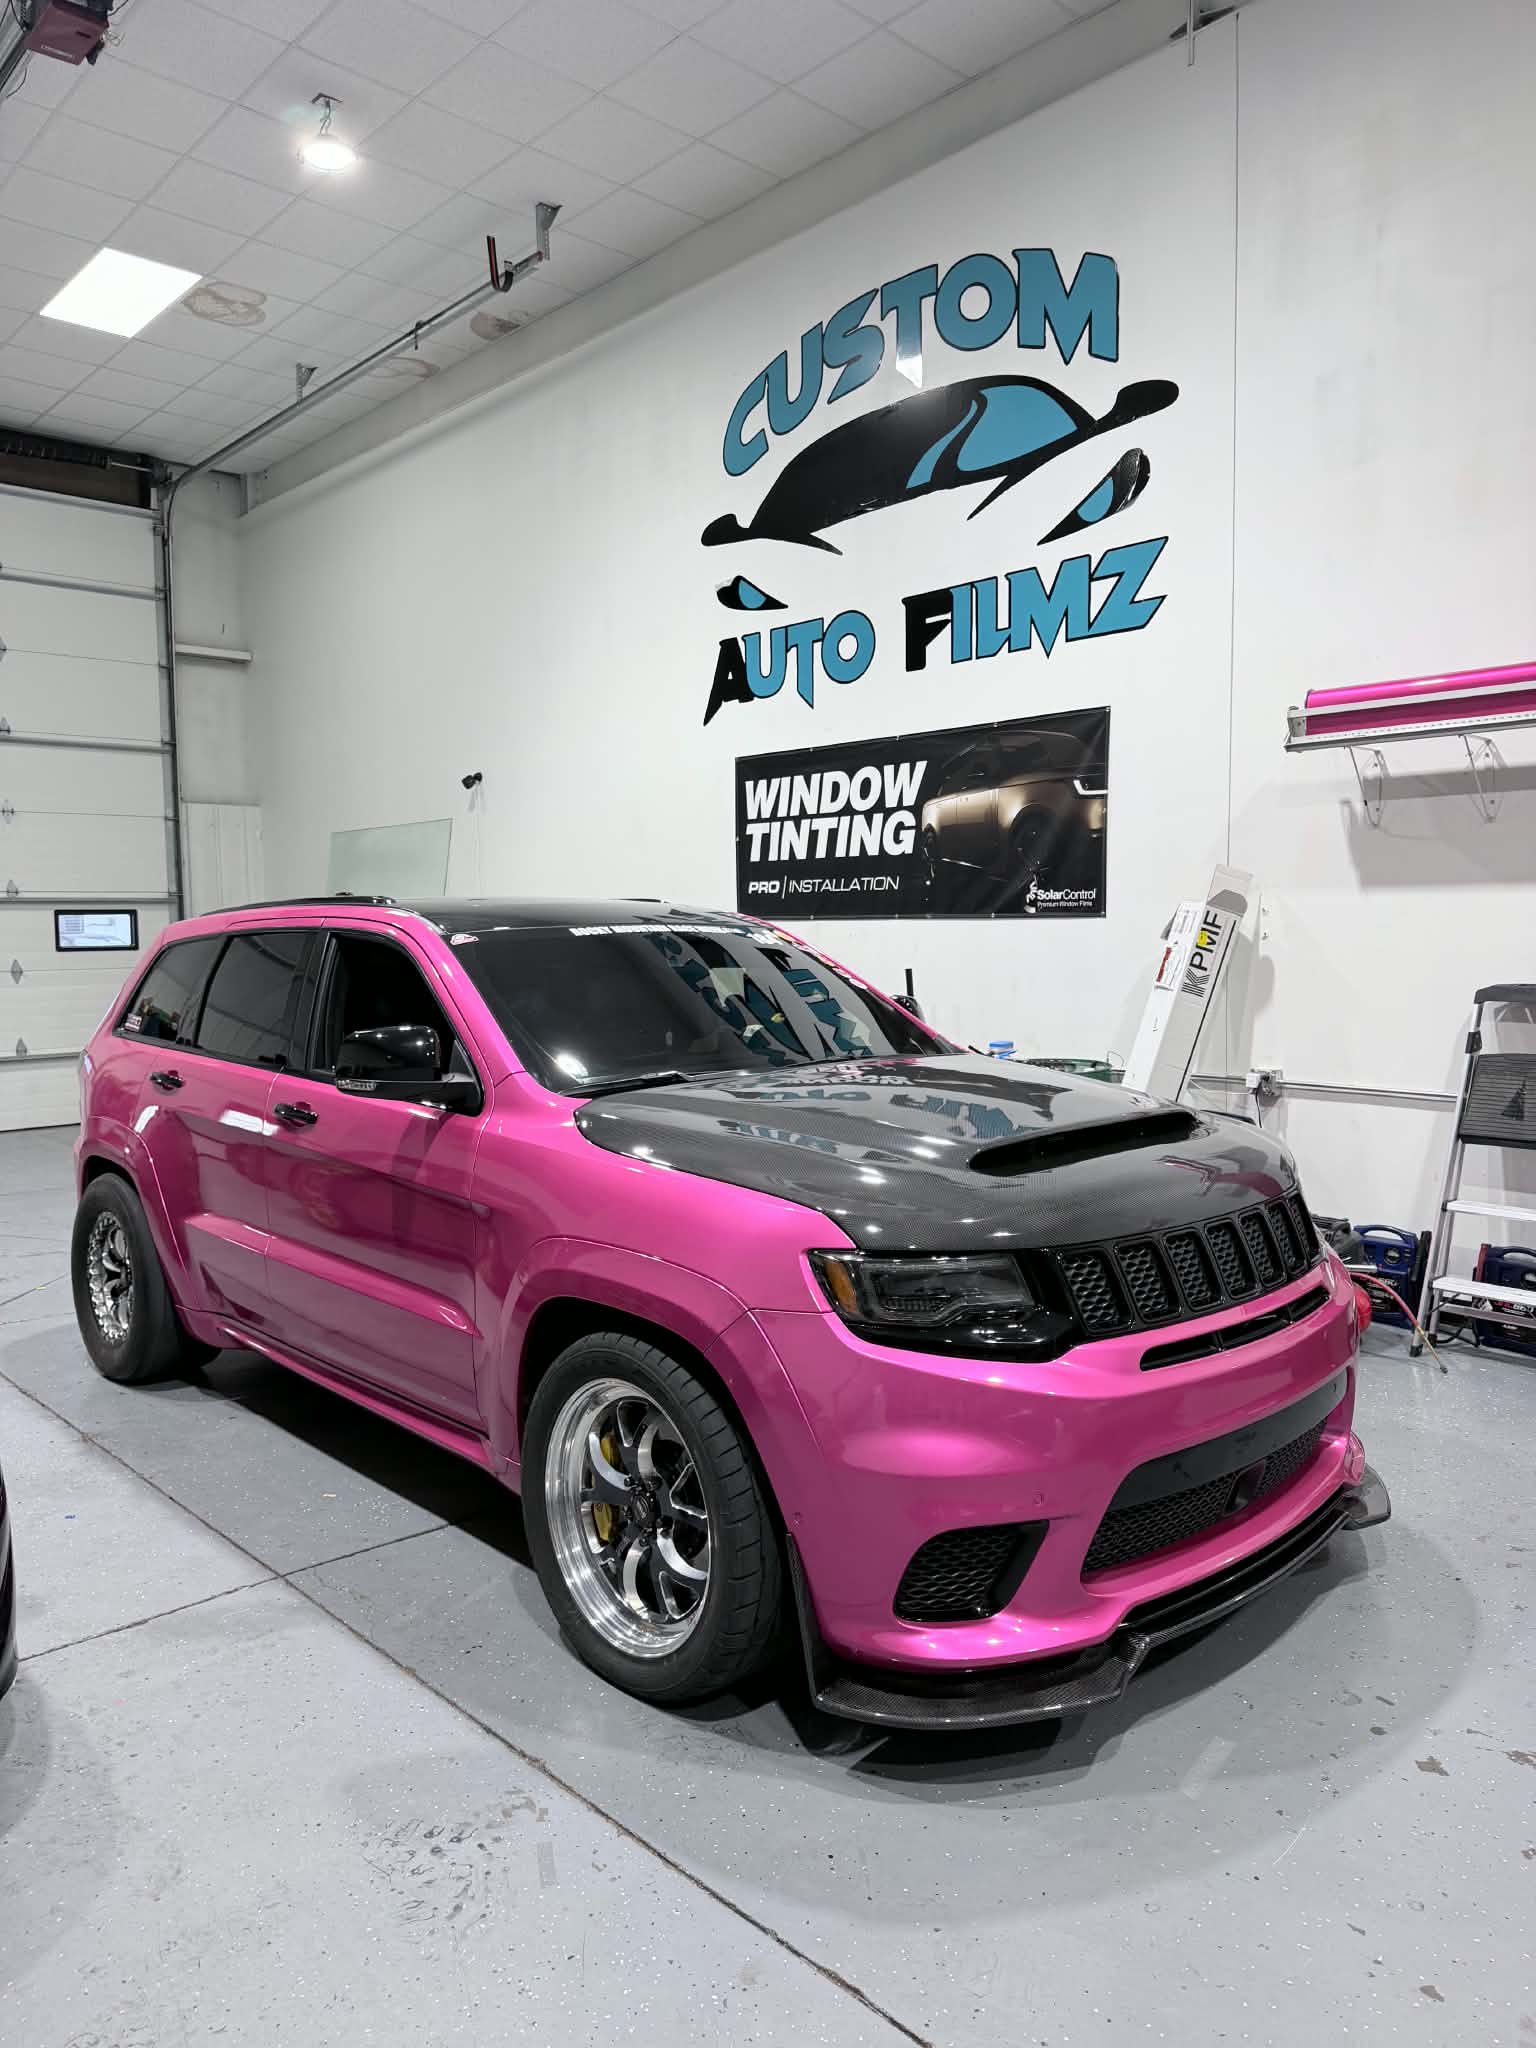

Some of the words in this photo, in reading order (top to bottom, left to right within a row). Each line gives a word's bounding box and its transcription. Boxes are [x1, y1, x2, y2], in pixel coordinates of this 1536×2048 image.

[722, 247, 1119, 477] CUSTOM
[703, 609, 875, 726] AUTO
[902, 536, 1168, 672] FILMZ
[745, 760, 928, 820] WINDOW
[746, 810, 917, 862] TINTING
[748, 880, 780, 895] PRO
[788, 875, 900, 893] INSTALLATION
[1181, 910, 1222, 998] KPMF
